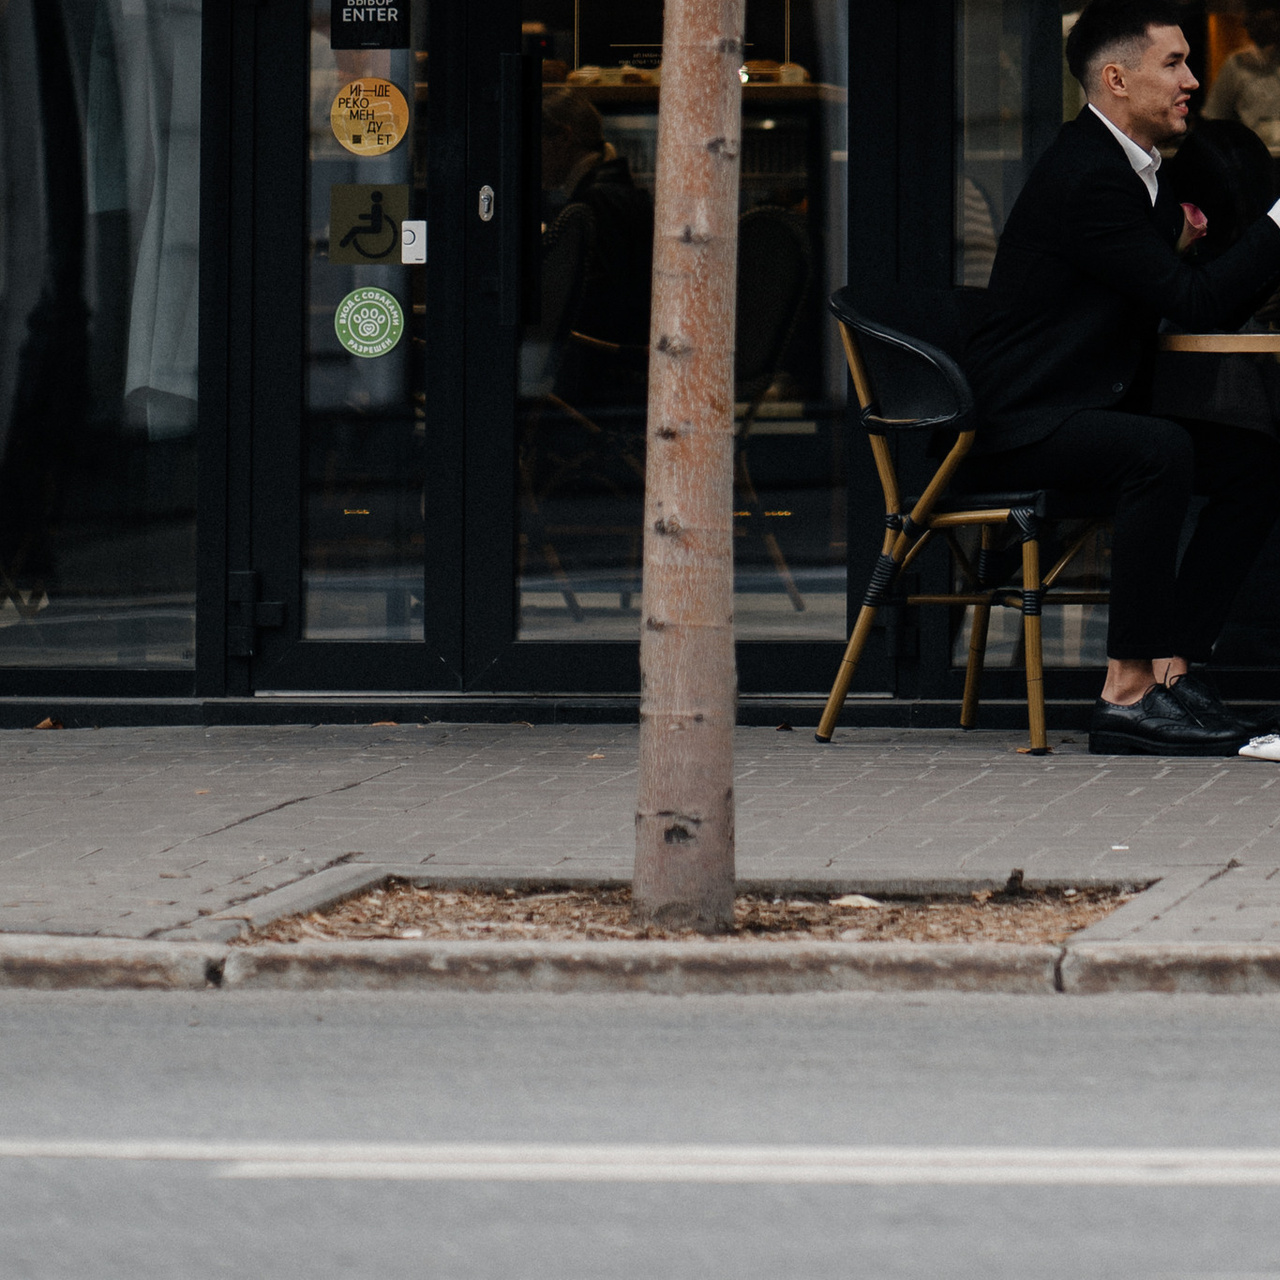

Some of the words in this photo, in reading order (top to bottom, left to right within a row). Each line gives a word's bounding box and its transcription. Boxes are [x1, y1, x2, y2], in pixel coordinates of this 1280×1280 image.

[342, 7, 398, 22] ENTER
[349, 109, 375, 121] МЕН
[367, 121, 383, 134] ДУ
[377, 133, 392, 145] ЕТ
[339, 300, 355, 325] ВХОД
[361, 291, 399, 326] СОБАКАМИ
[347, 337, 393, 354] РАЗРЕШЕН
